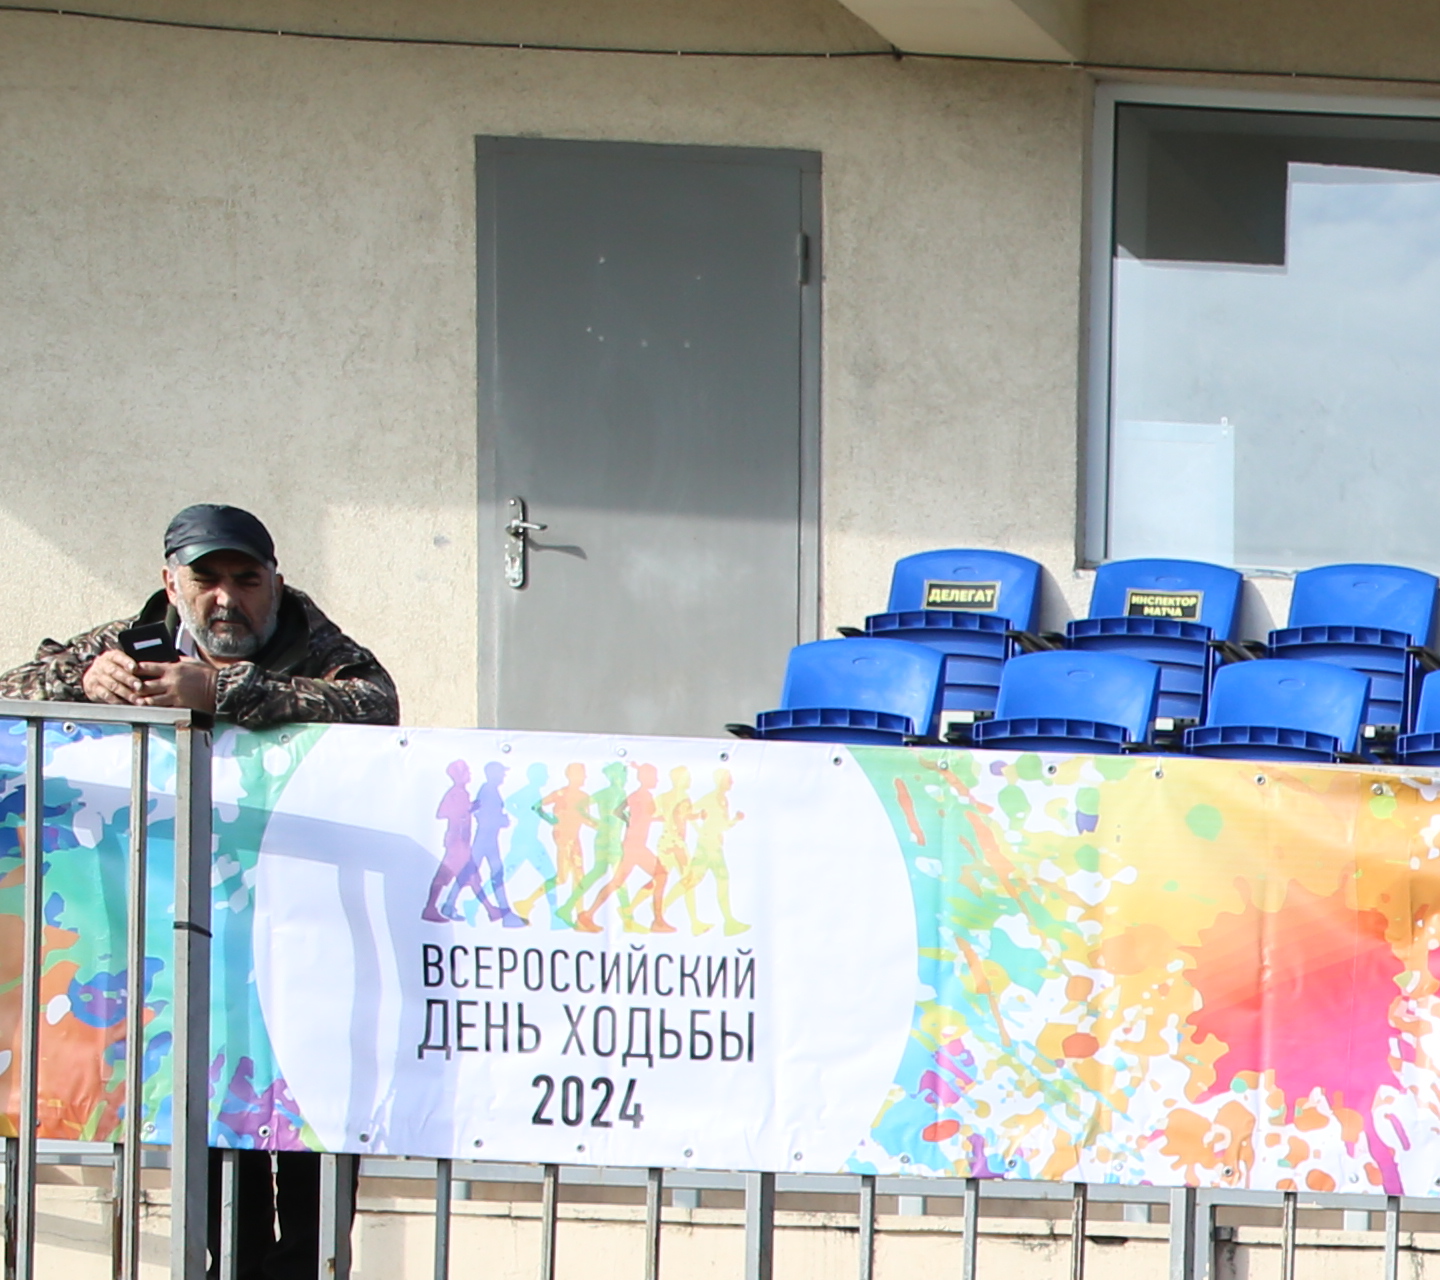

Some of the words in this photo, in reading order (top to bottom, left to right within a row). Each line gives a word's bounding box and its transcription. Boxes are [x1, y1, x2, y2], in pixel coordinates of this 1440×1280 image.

[928, 588, 995, 603] ДЕЛЕГАТ
[1131, 593, 1198, 607] ИНСПЕКТОР
[1143, 605, 1183, 618] МАТЧА
[422, 944, 755, 1000] ВСЕРОССИЙСКИЙ
[417, 998, 542, 1060] ДЕНЬ
[561, 1004, 755, 1068] ХОДЬБЫ
[531, 1074, 644, 1129] 2024
